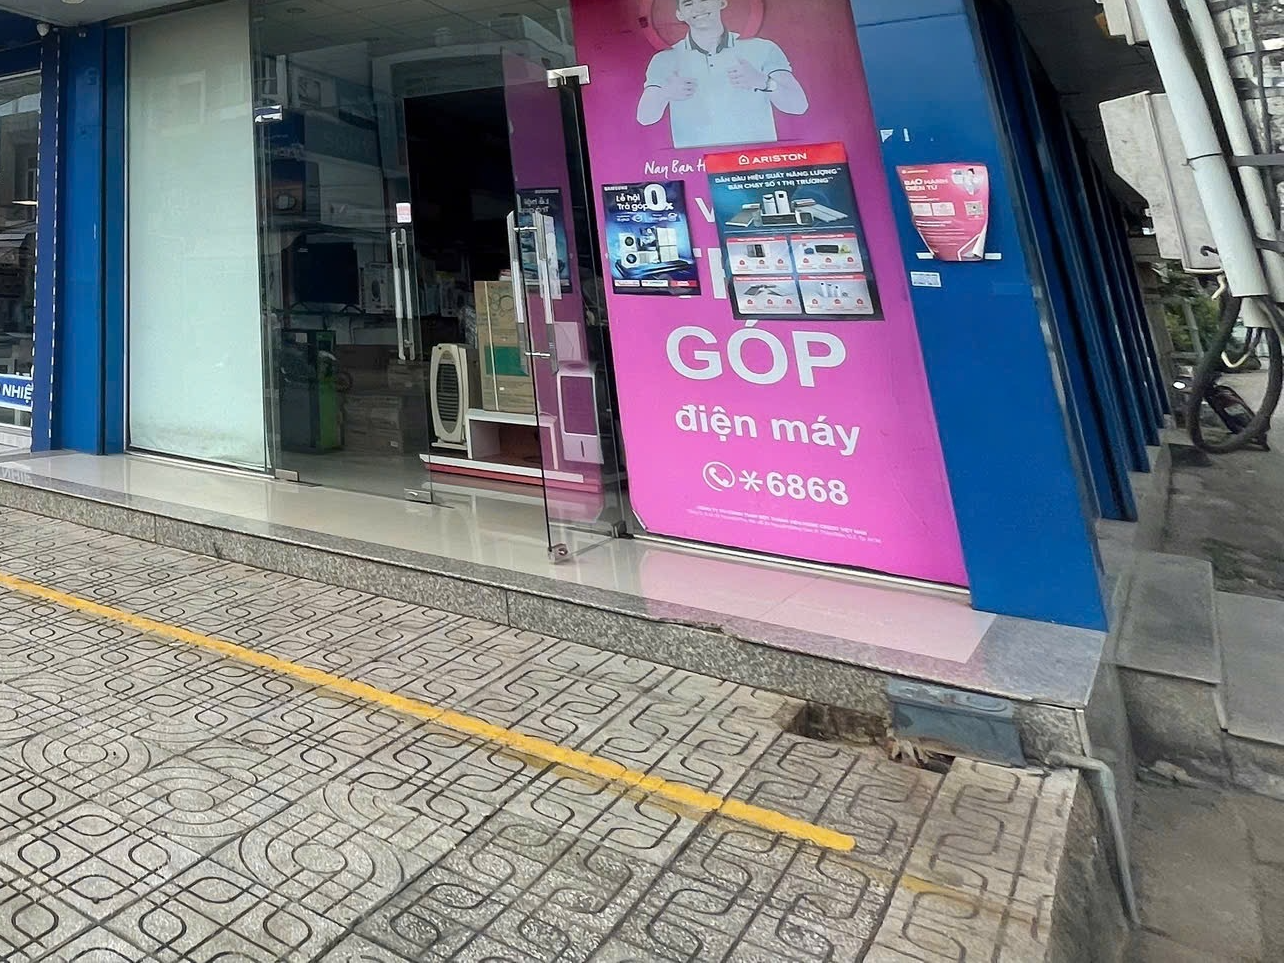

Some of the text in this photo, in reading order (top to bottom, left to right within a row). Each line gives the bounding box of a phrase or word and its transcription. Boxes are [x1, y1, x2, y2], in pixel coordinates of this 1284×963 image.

[752, 152, 808, 164] ARISTON
[644, 160, 669, 179] Nay
[671, 159, 694, 174] Bạn
[765, 180, 776, 188] SỐ
[616, 193, 641, 202] Lễ hội
[617, 201, 631, 210] Trả
[631, 201, 648, 211] góp
[666, 319, 847, 388] GÓP
[2, 383, 33, 403] NHIỆ
[675, 404, 861, 456] điện máy
